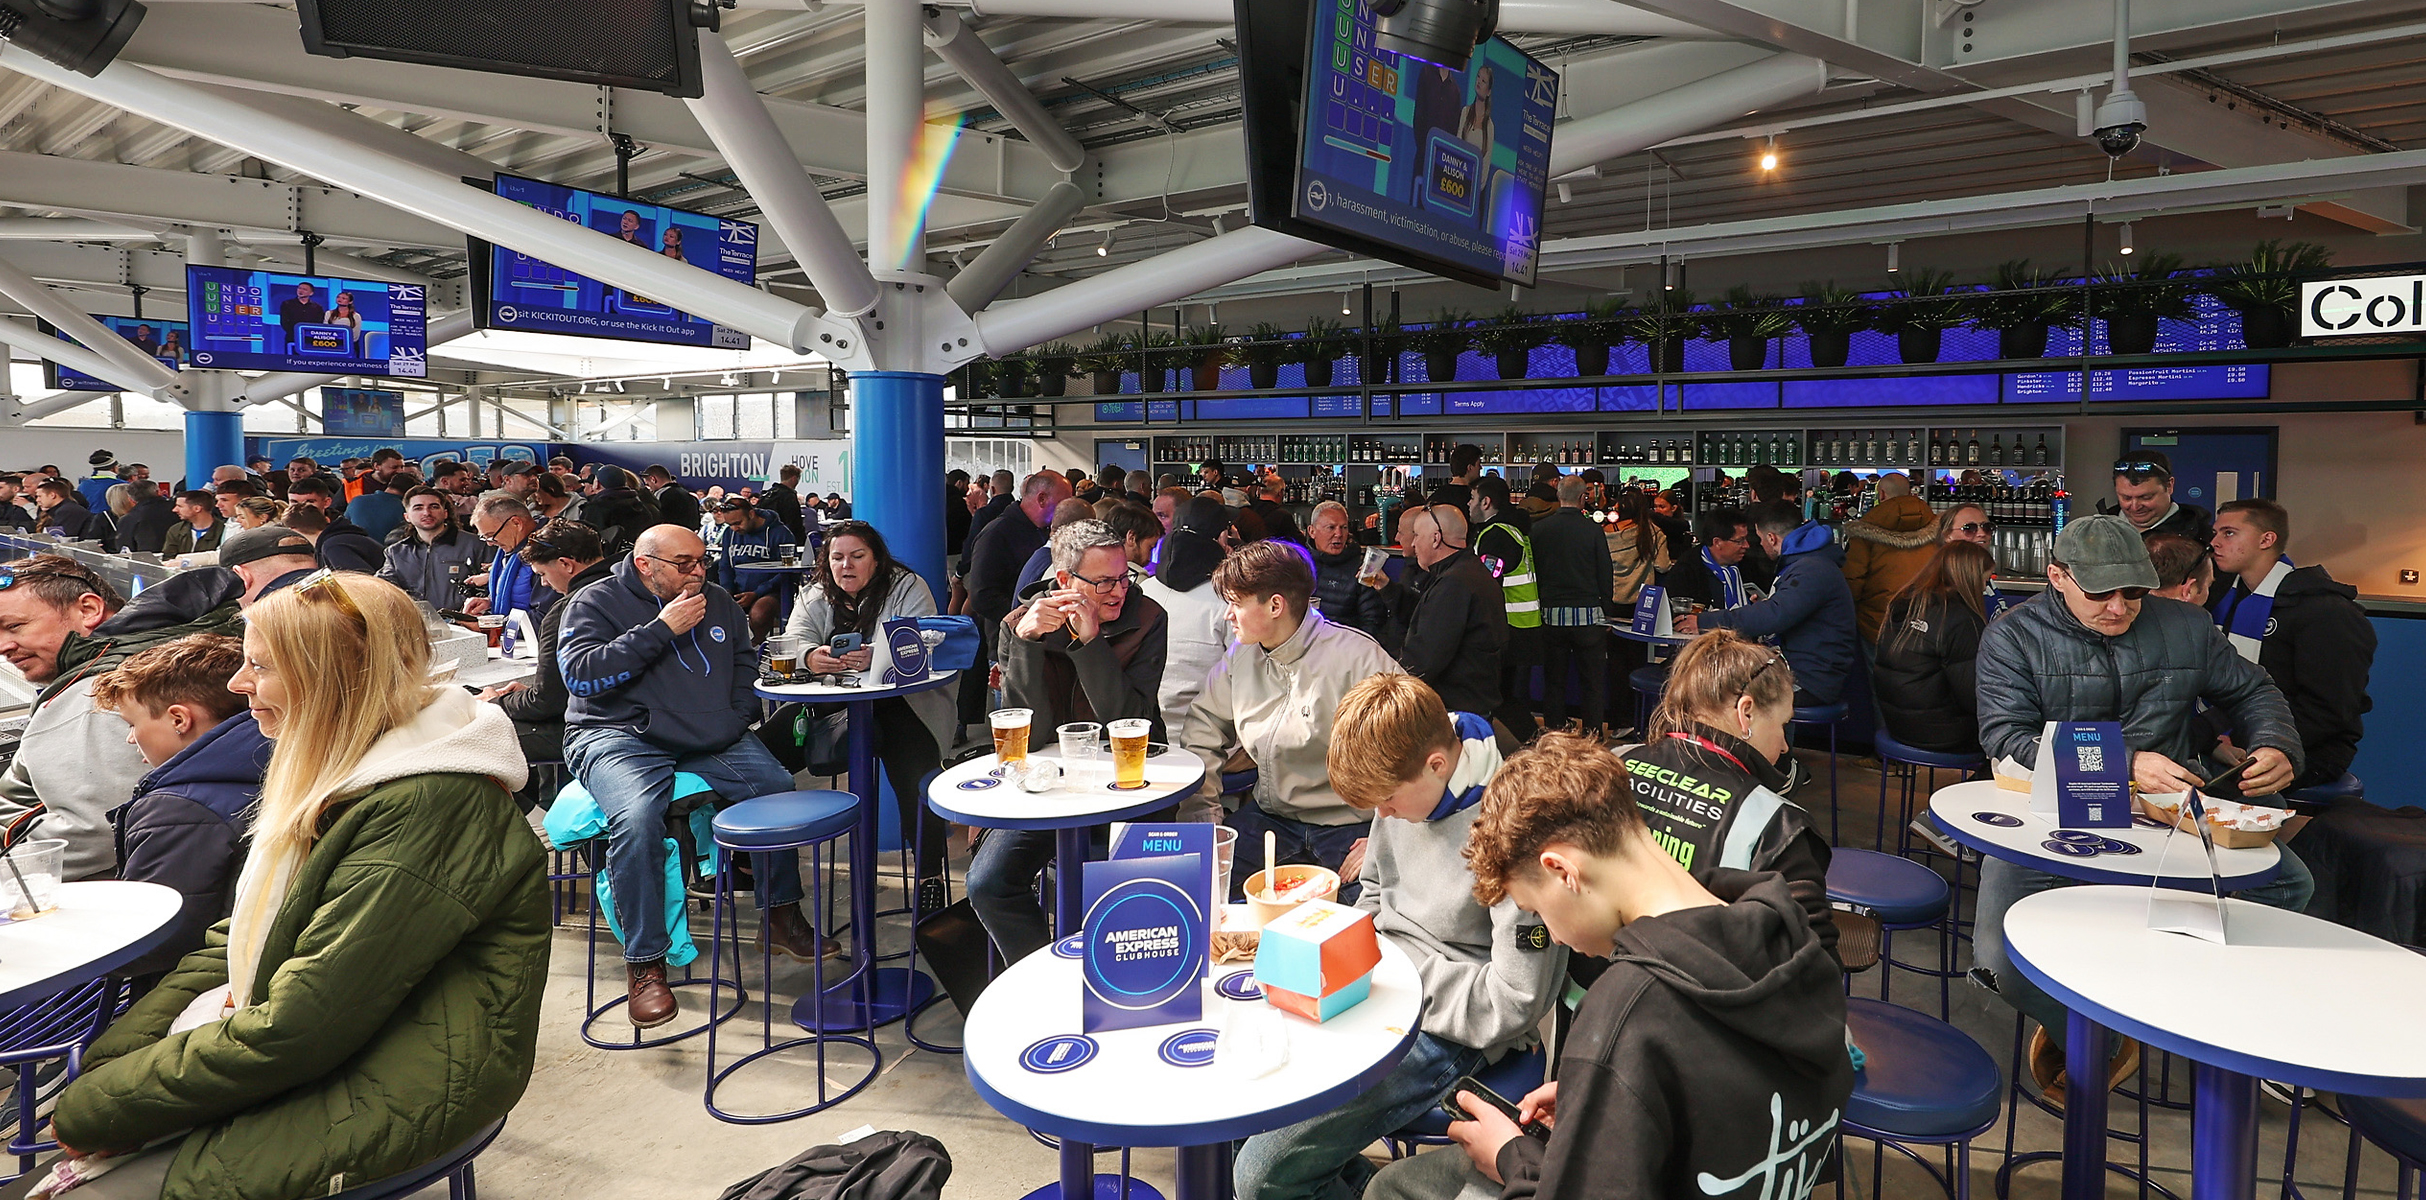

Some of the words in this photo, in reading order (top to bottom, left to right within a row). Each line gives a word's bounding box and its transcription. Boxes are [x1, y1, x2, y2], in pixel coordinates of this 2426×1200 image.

[1336, 46, 1396, 92] USER
[1441, 152, 1463, 168] DANNY
[1462, 162, 1468, 171] &
[1442, 165, 1465, 180] ALISON
[1440, 177, 1464, 198] £600
[1336, 192, 1389, 225] harassment,
[1389, 212, 1440, 241] victimisation,
[1440, 231, 1449, 241] or
[1449, 232, 1471, 251] abuse,
[1471, 241, 1493, 256] please
[720, 247, 731, 255] The
[731, 249, 754, 259] Terrace
[1517, 248, 1523, 258] 29
[1511, 261, 1528, 277] 14.41
[207, 283, 260, 295] UNDO
[208, 294, 260, 304] UNIT
[208, 304, 261, 315] USER
[531, 311, 599, 326] KICKITOUT.ORG,
[627, 321, 640, 329] the
[641, 322, 658, 331] Kick
[659, 324, 665, 332] It
[666, 325, 680, 333] Out
[681, 328, 695, 336] app
[312, 339, 338, 348] £600
[720, 336, 740, 344] 14.41
[293, 359, 307, 367] you
[1470, 400, 1486, 409] Apply
[292, 438, 369, 459] Greetings
[680, 452, 767, 479] BRIGHTON
[791, 454, 819, 471] HOVE
[800, 468, 819, 484] ION
[729, 543, 771, 559] HAFC
[2072, 732, 2101, 741] MENU
[1625, 758, 1733, 805] SEECLEAR
[1629, 778, 1723, 821] CILITIES
[1142, 838, 1182, 852] MENU
[1647, 826, 1696, 872] ning
[1105, 925, 1178, 944] AMERICAN
[1115, 937, 1180, 954] EXPRESS
[1115, 948, 1180, 962] CLUBHOUSE
